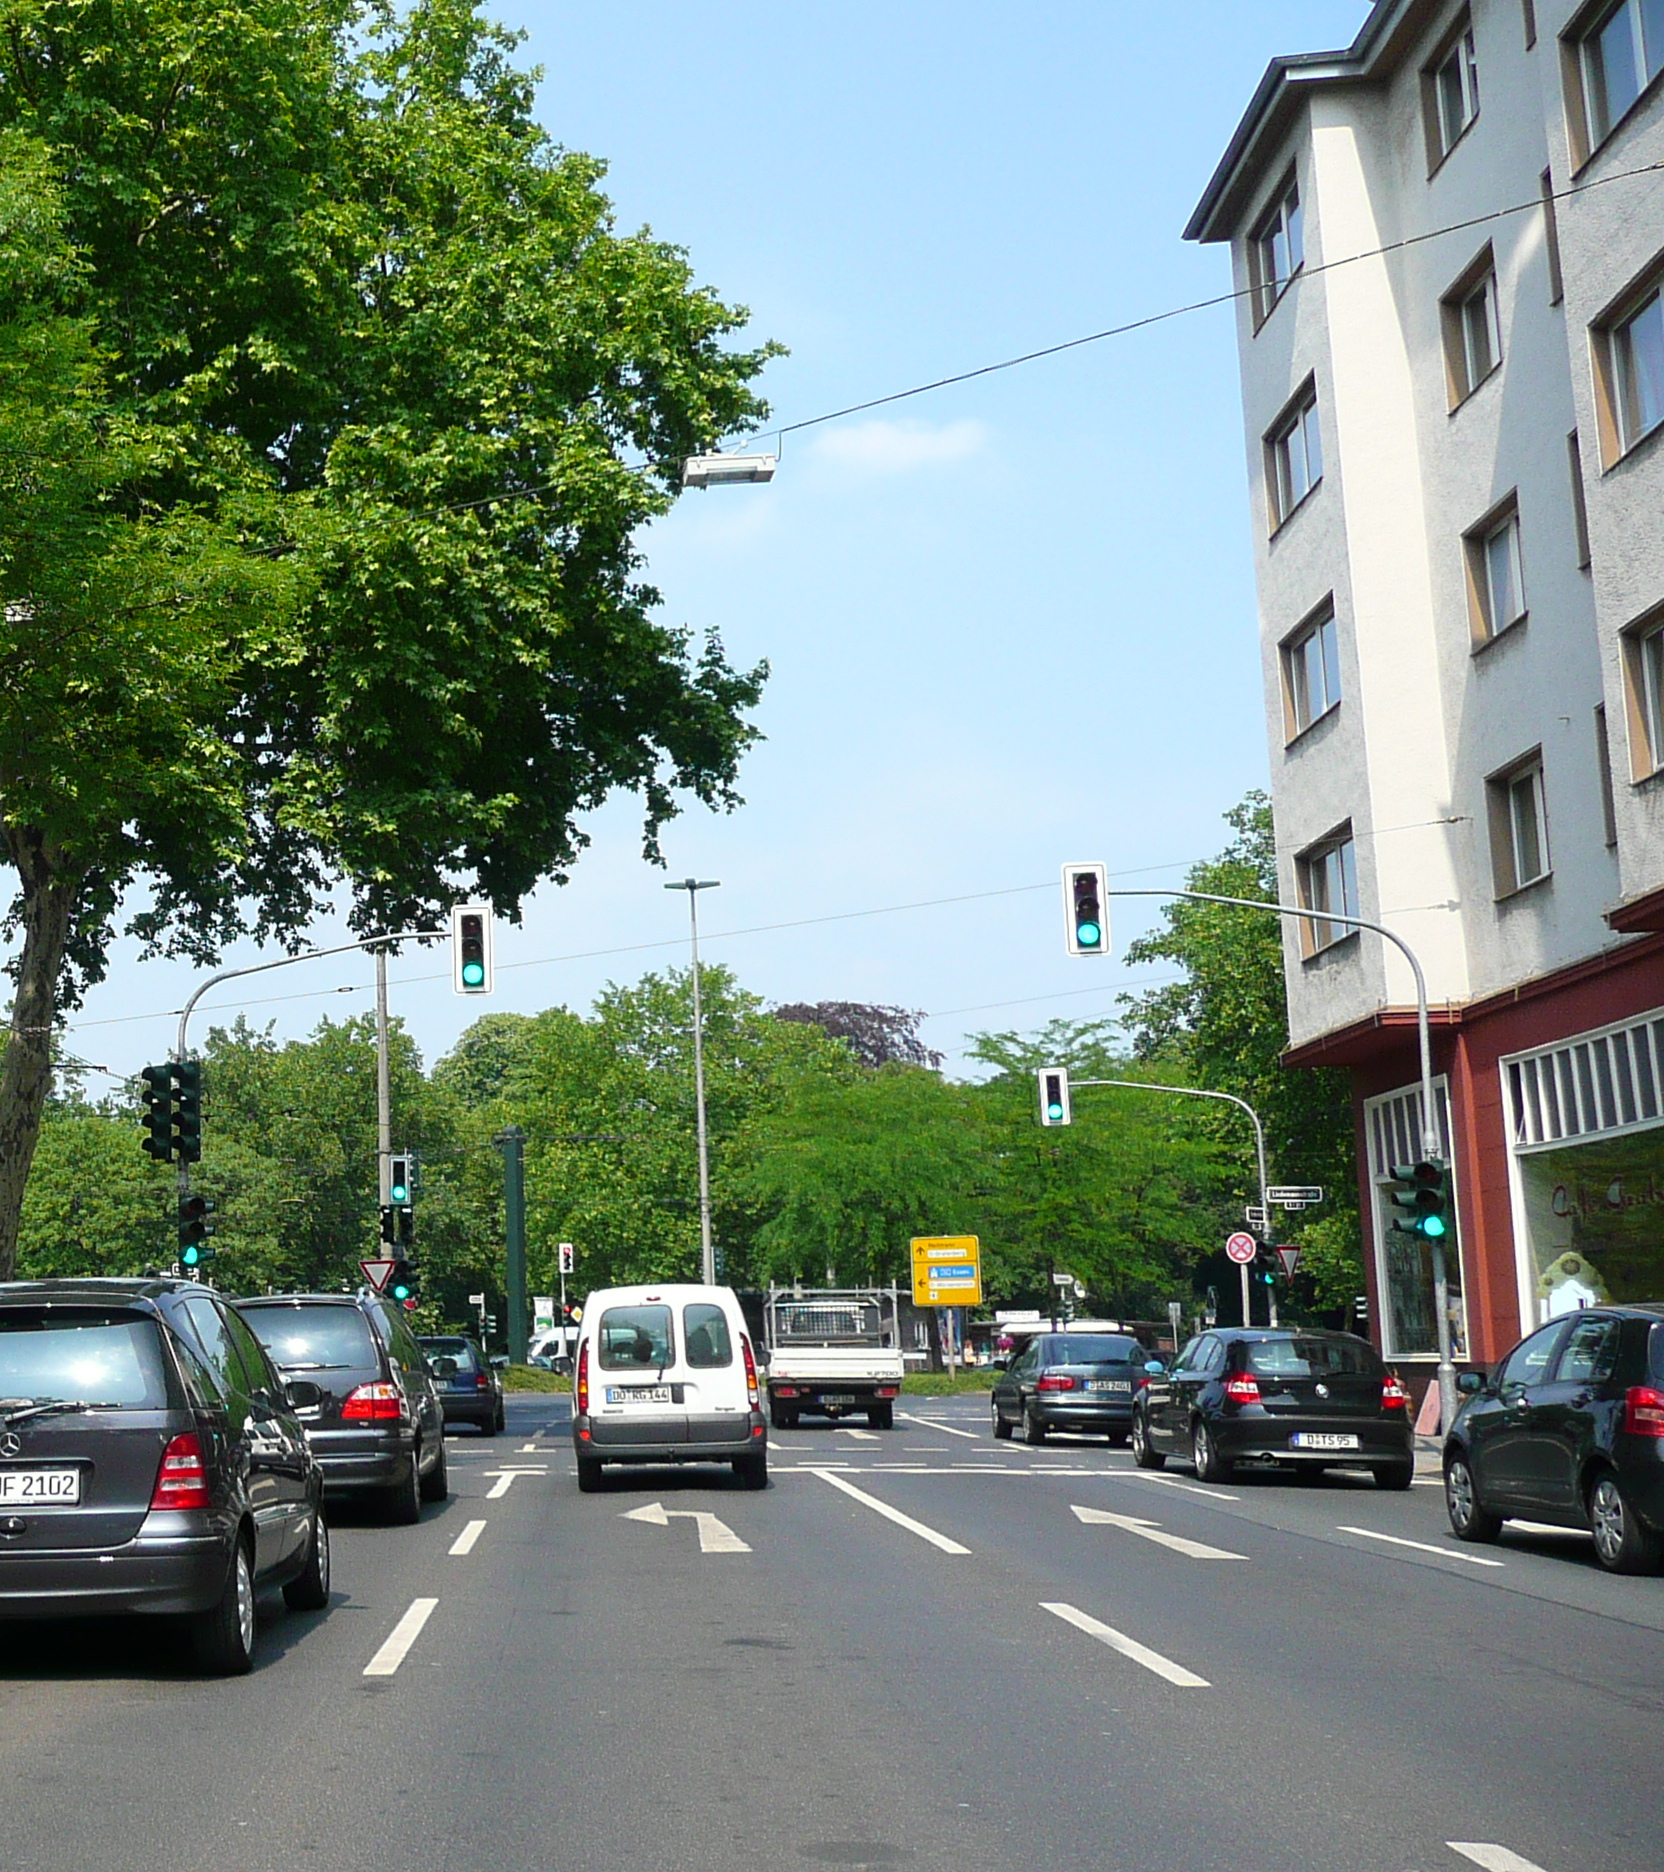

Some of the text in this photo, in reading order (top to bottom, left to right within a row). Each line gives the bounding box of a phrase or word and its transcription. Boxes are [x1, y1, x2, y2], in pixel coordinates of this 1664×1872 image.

[632, 1389, 647, 1400] RG
[648, 1389, 668, 1400] 144
[1321, 1434, 1335, 1446] TS
[1336, 1435, 1350, 1446] 95
[22, 1475, 75, 1496] 2102
